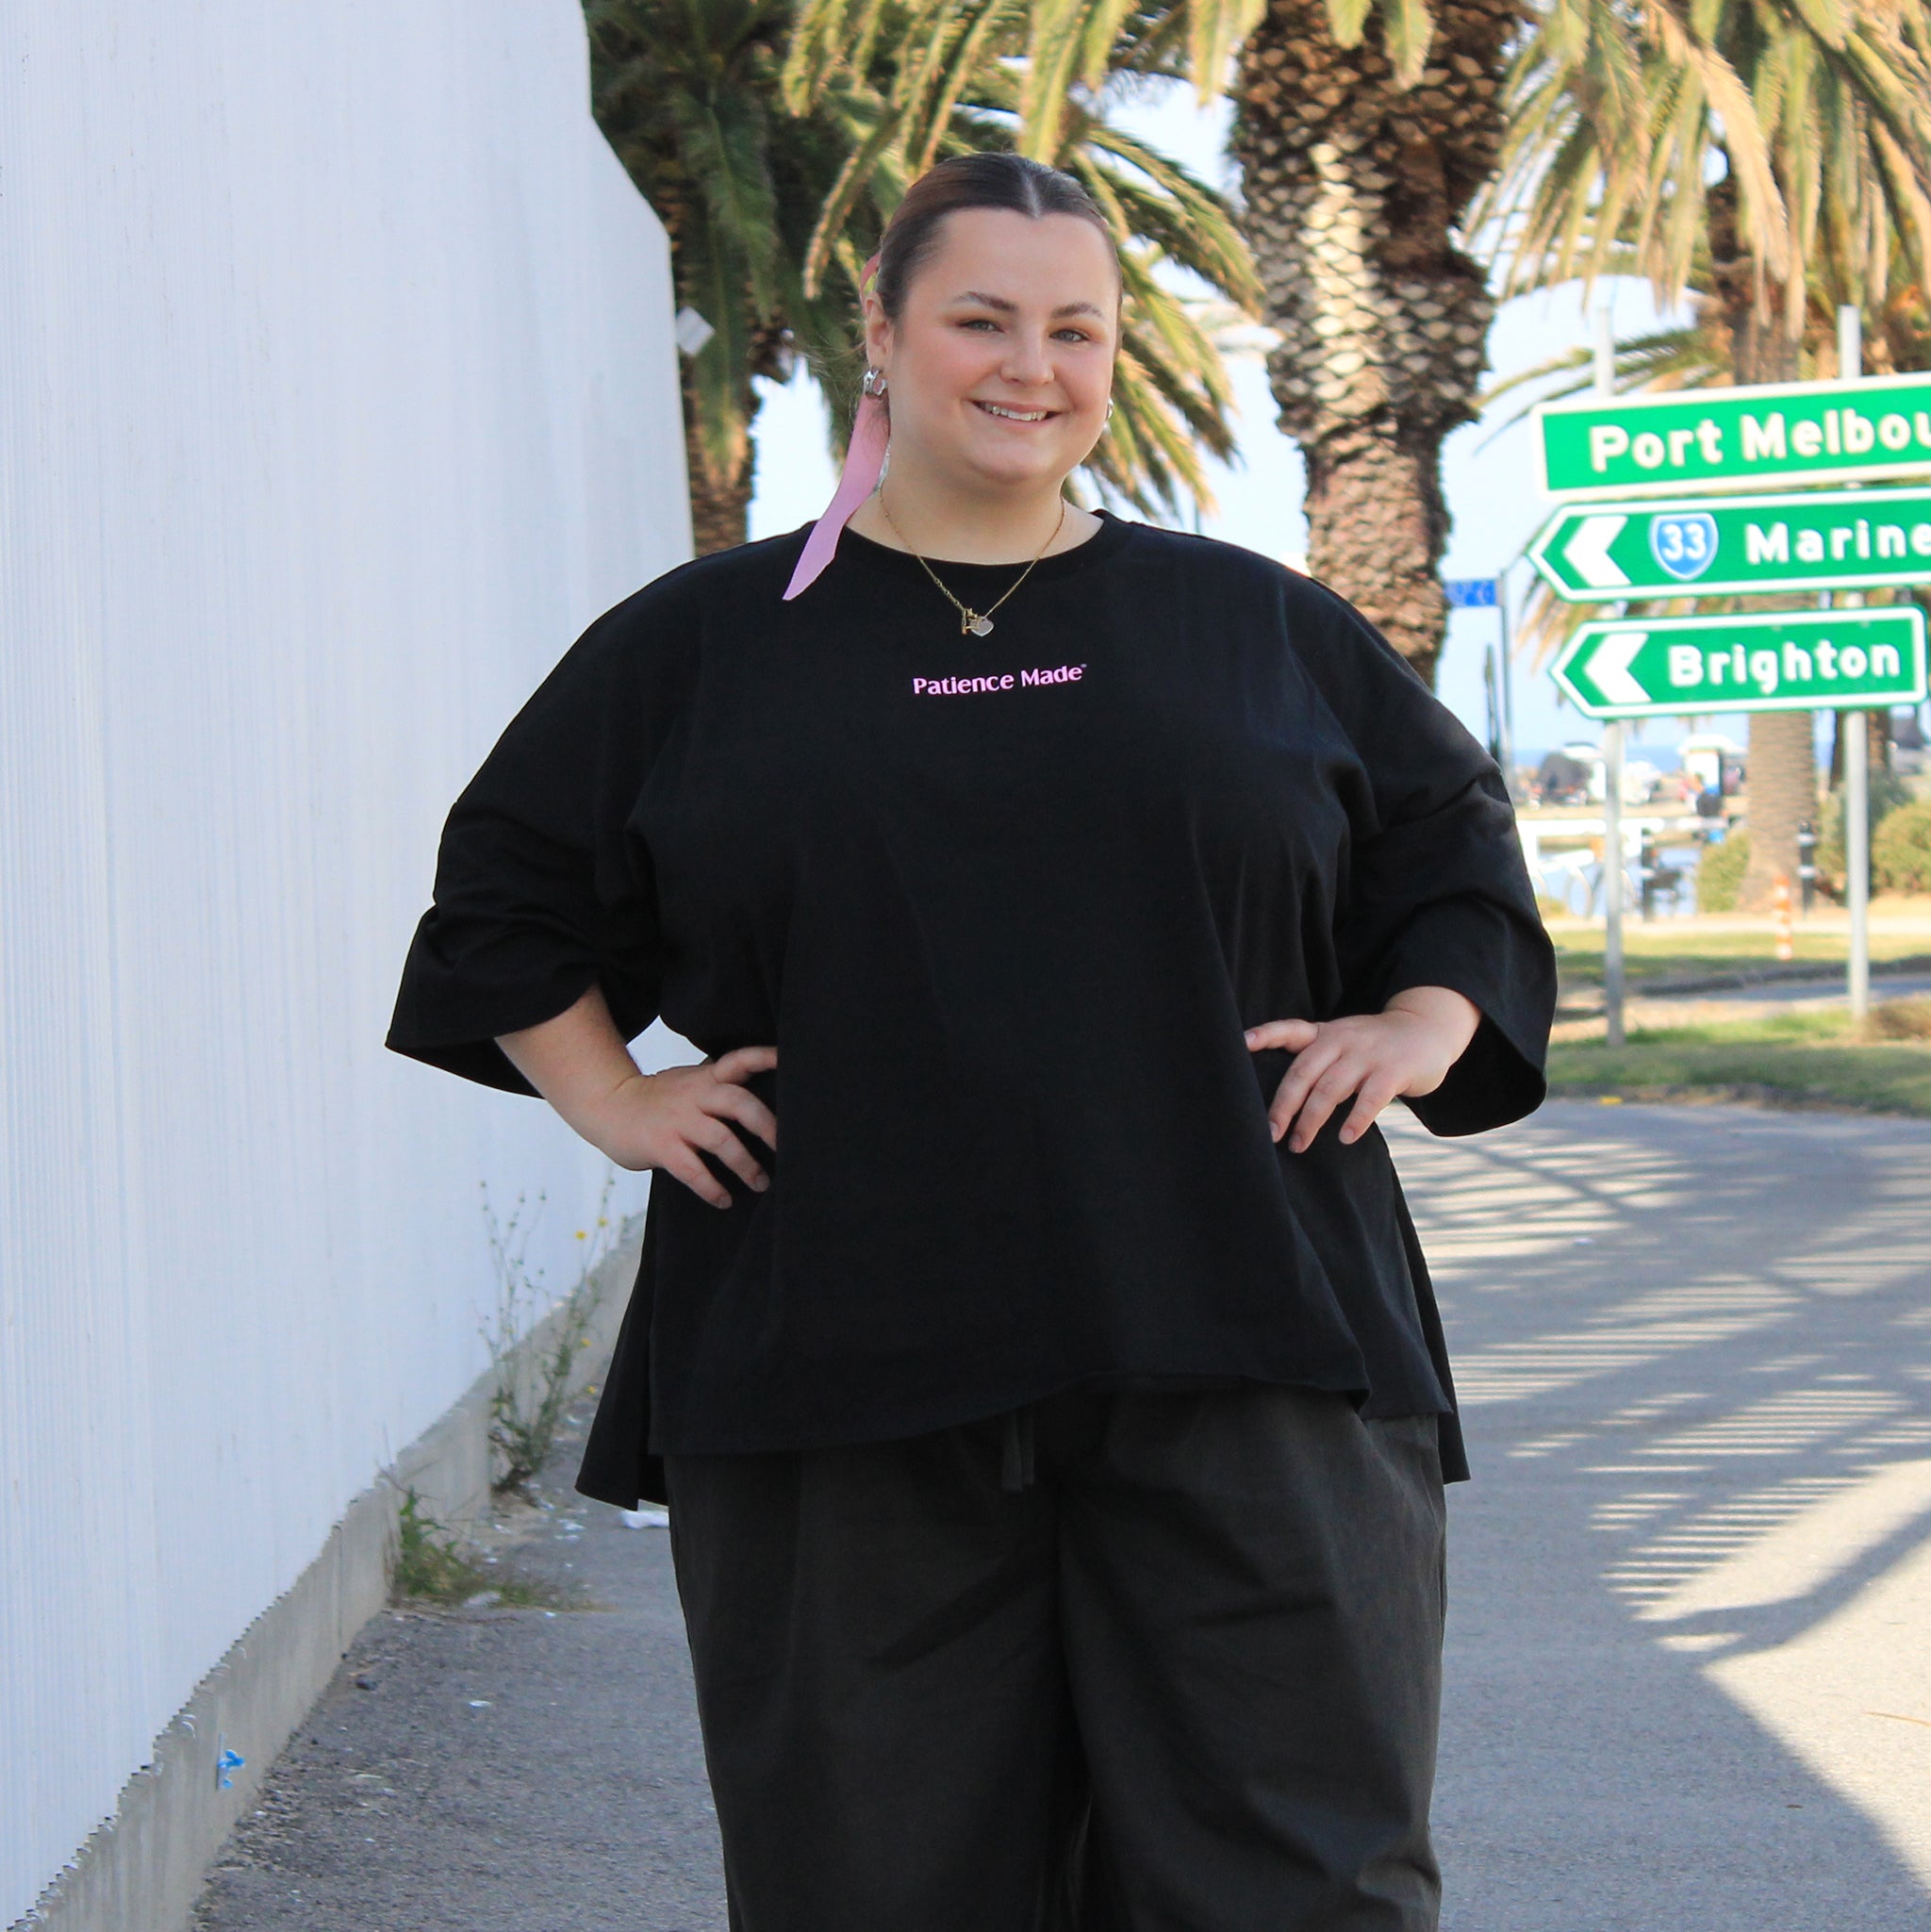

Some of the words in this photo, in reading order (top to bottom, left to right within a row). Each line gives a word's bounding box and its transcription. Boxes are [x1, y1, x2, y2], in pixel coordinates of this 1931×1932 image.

[1589, 419, 1724, 472] Port
[1660, 523, 1708, 560] 33
[1744, 519, 1931, 565] Marine
[913, 674, 1015, 695] Patience
[1667, 638, 1901, 694] Brighton
